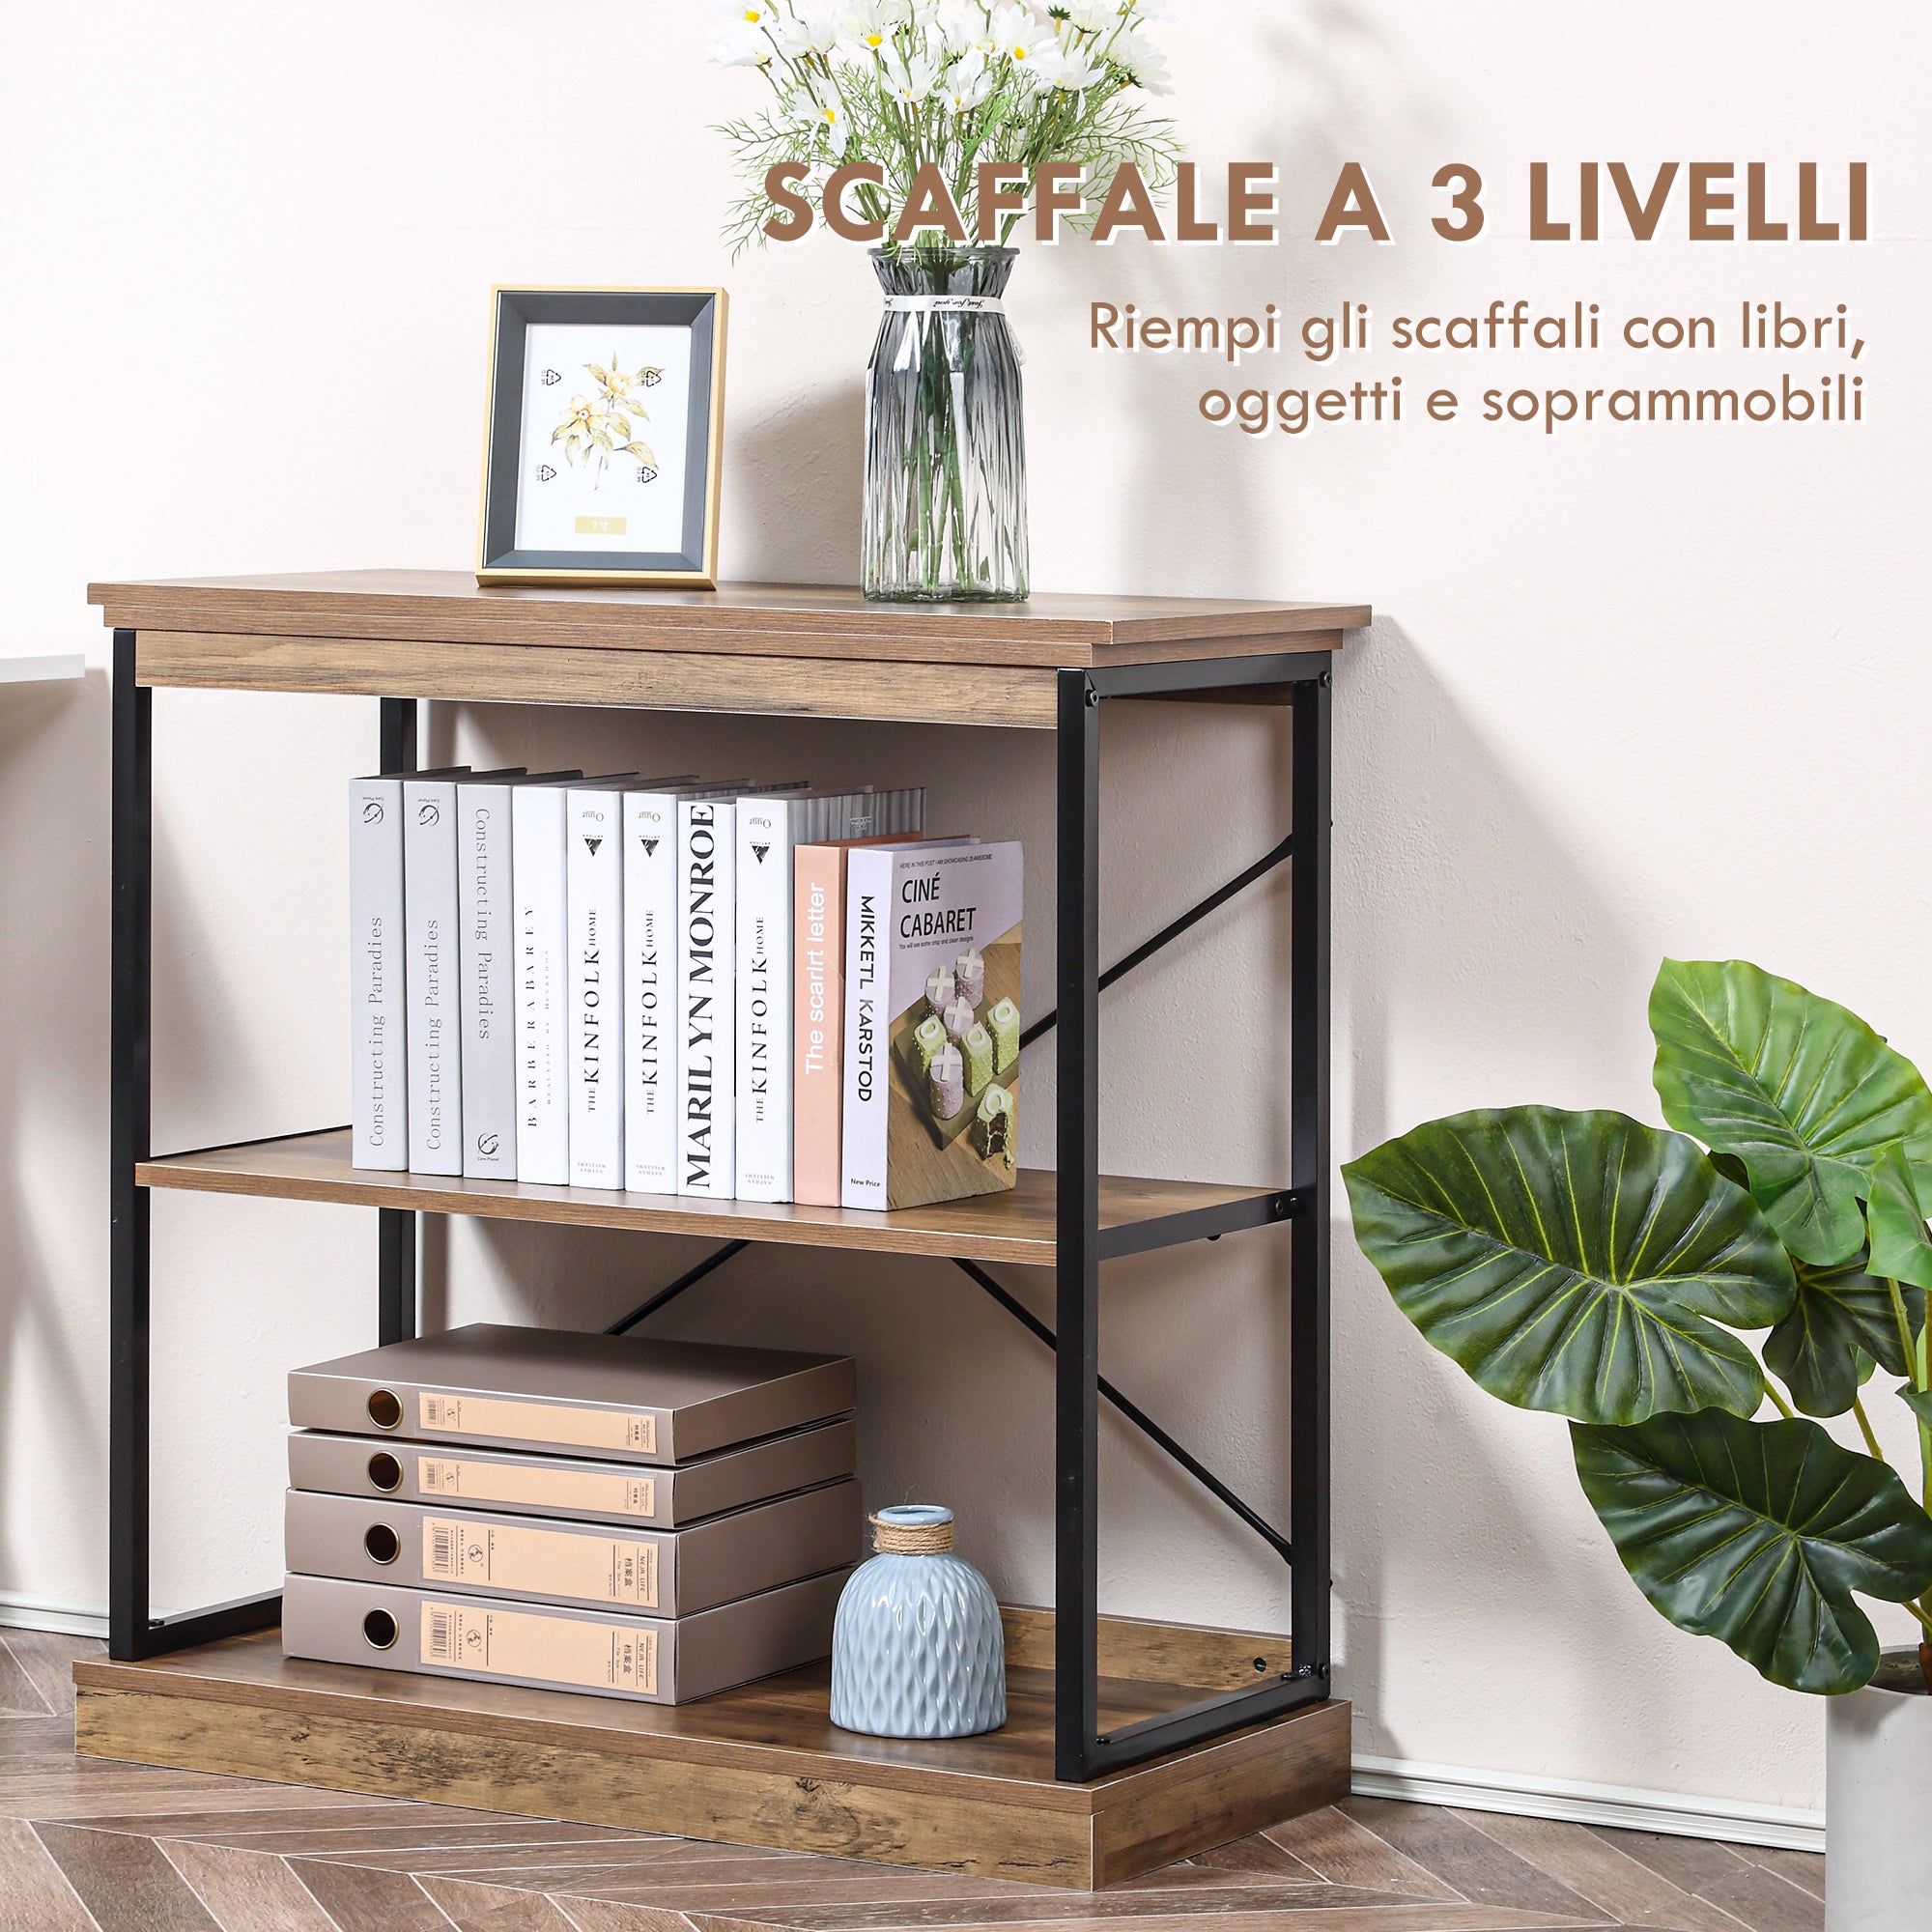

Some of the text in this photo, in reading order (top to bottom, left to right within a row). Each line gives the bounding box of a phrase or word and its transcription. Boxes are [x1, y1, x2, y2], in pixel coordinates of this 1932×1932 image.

[475, 808, 494, 1039] Constructing Paradies
[689, 804, 715, 985] MONROE
[806, 882, 825, 943] letter
[900, 907, 977, 939] CABARET
[901, 871, 941, 904] CINÉ
[368, 917, 385, 1147] Constructing Paradies
[424, 920, 441, 1151] Constructing Paradies
[584, 909, 600, 1113] THE KINFOLK HOME
[641, 910, 658, 1115] THE KINFOLK HOME
[752, 917, 768, 1123] THE KINFOLK HOME
[806, 1029, 824, 1074] The
[858, 895, 875, 1102] MIKKETL KARSTOD
